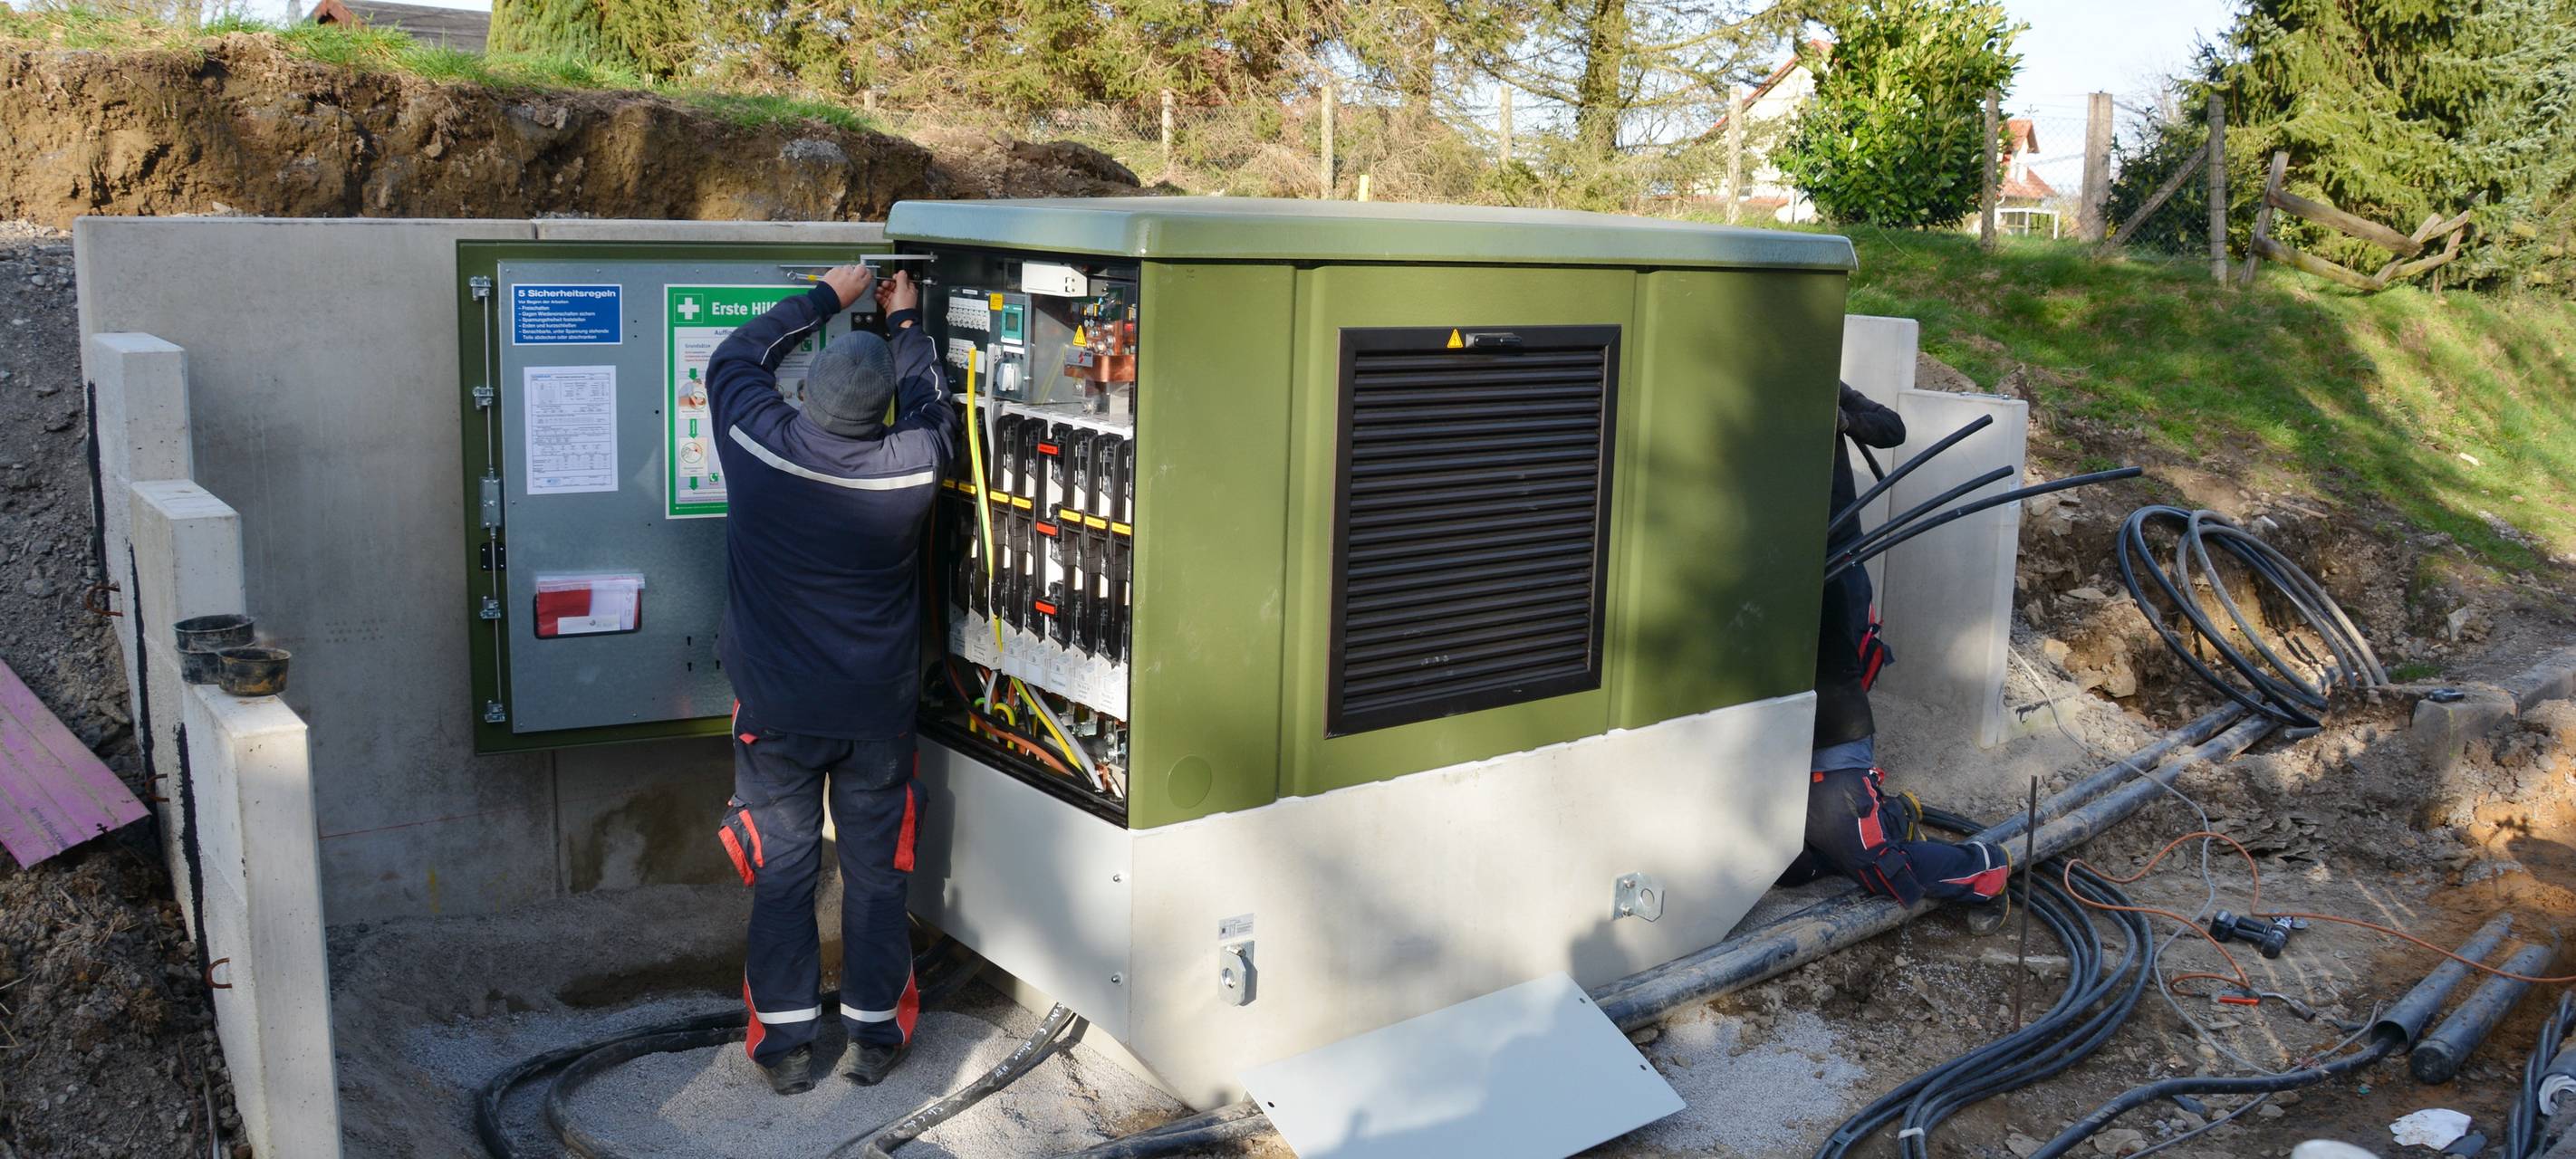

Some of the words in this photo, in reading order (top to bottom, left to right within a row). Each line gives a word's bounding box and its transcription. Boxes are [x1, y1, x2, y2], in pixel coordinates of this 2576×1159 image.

[528, 290, 616, 299] Sicherheitsregeln
[712, 302, 747, 315] Erste
[752, 302, 778, 315] Hilf
